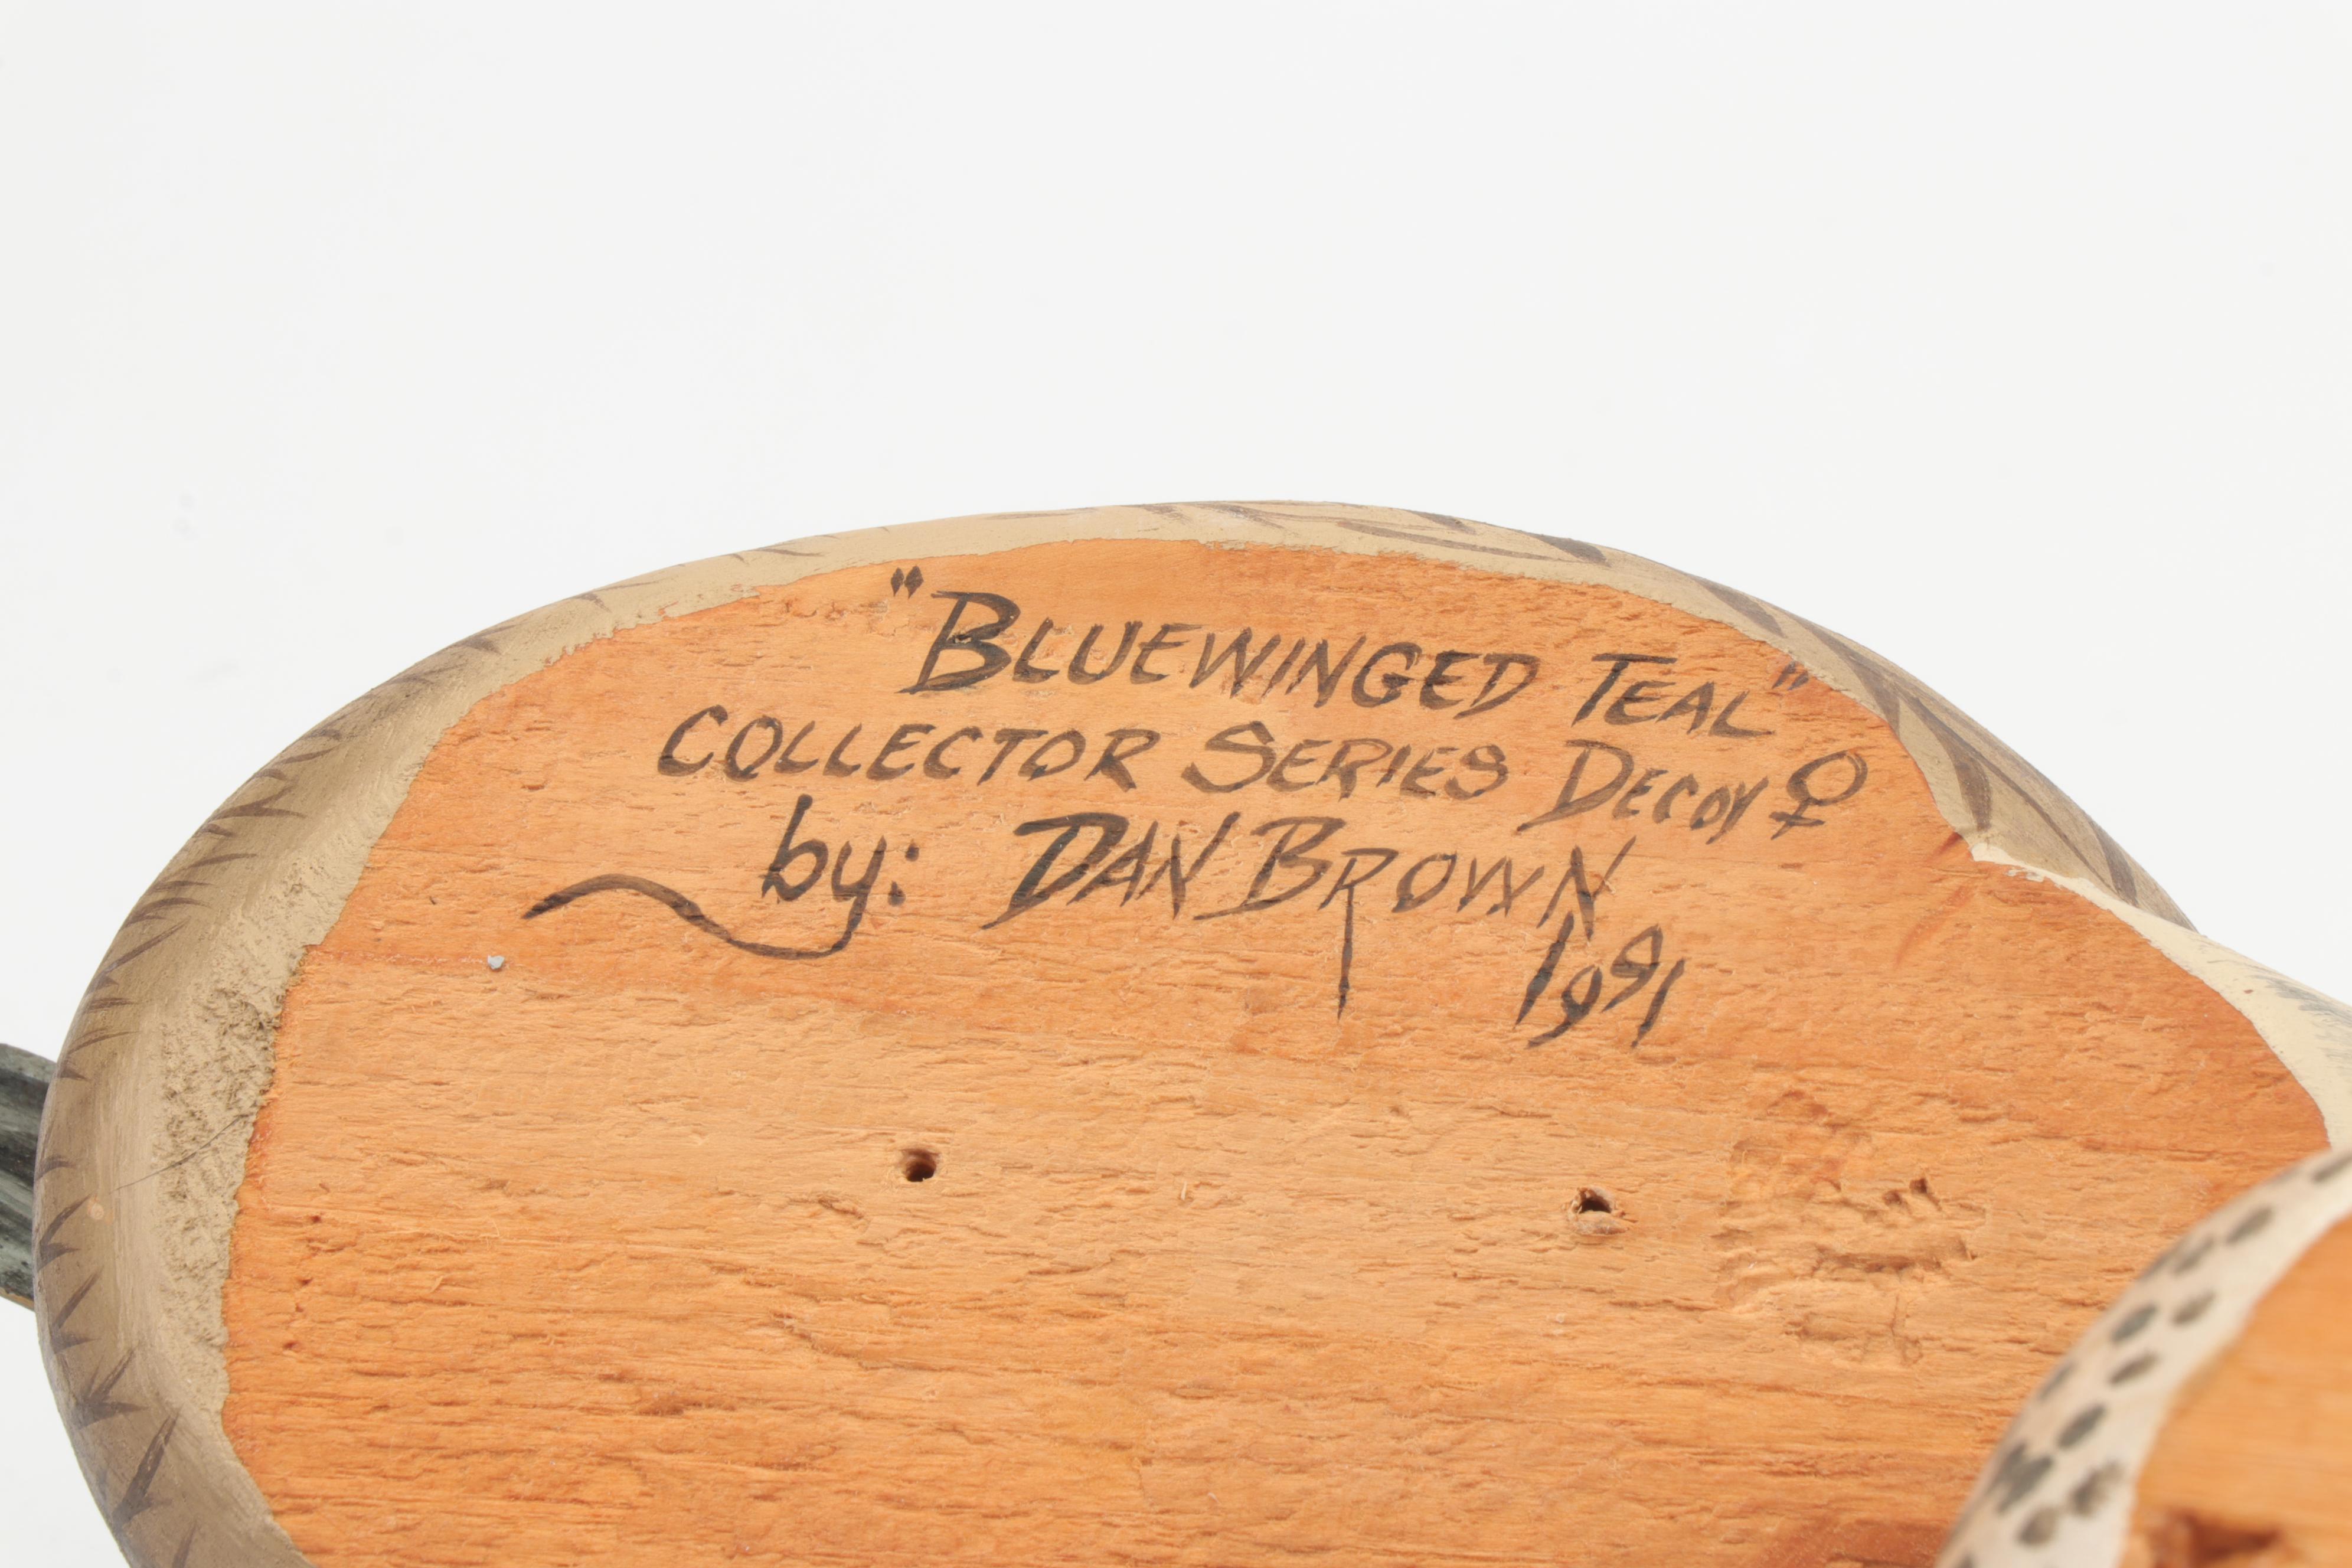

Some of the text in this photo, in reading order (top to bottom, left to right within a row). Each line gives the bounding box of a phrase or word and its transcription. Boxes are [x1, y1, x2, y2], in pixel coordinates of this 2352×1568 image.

[656, 704, 1770, 845] COLLECTOR SERIES DECOY
[981, 811, 1241, 930] DAN
[1193, 815, 1638, 1021] BROWN
[1514, 911, 1687, 1050] 1991
